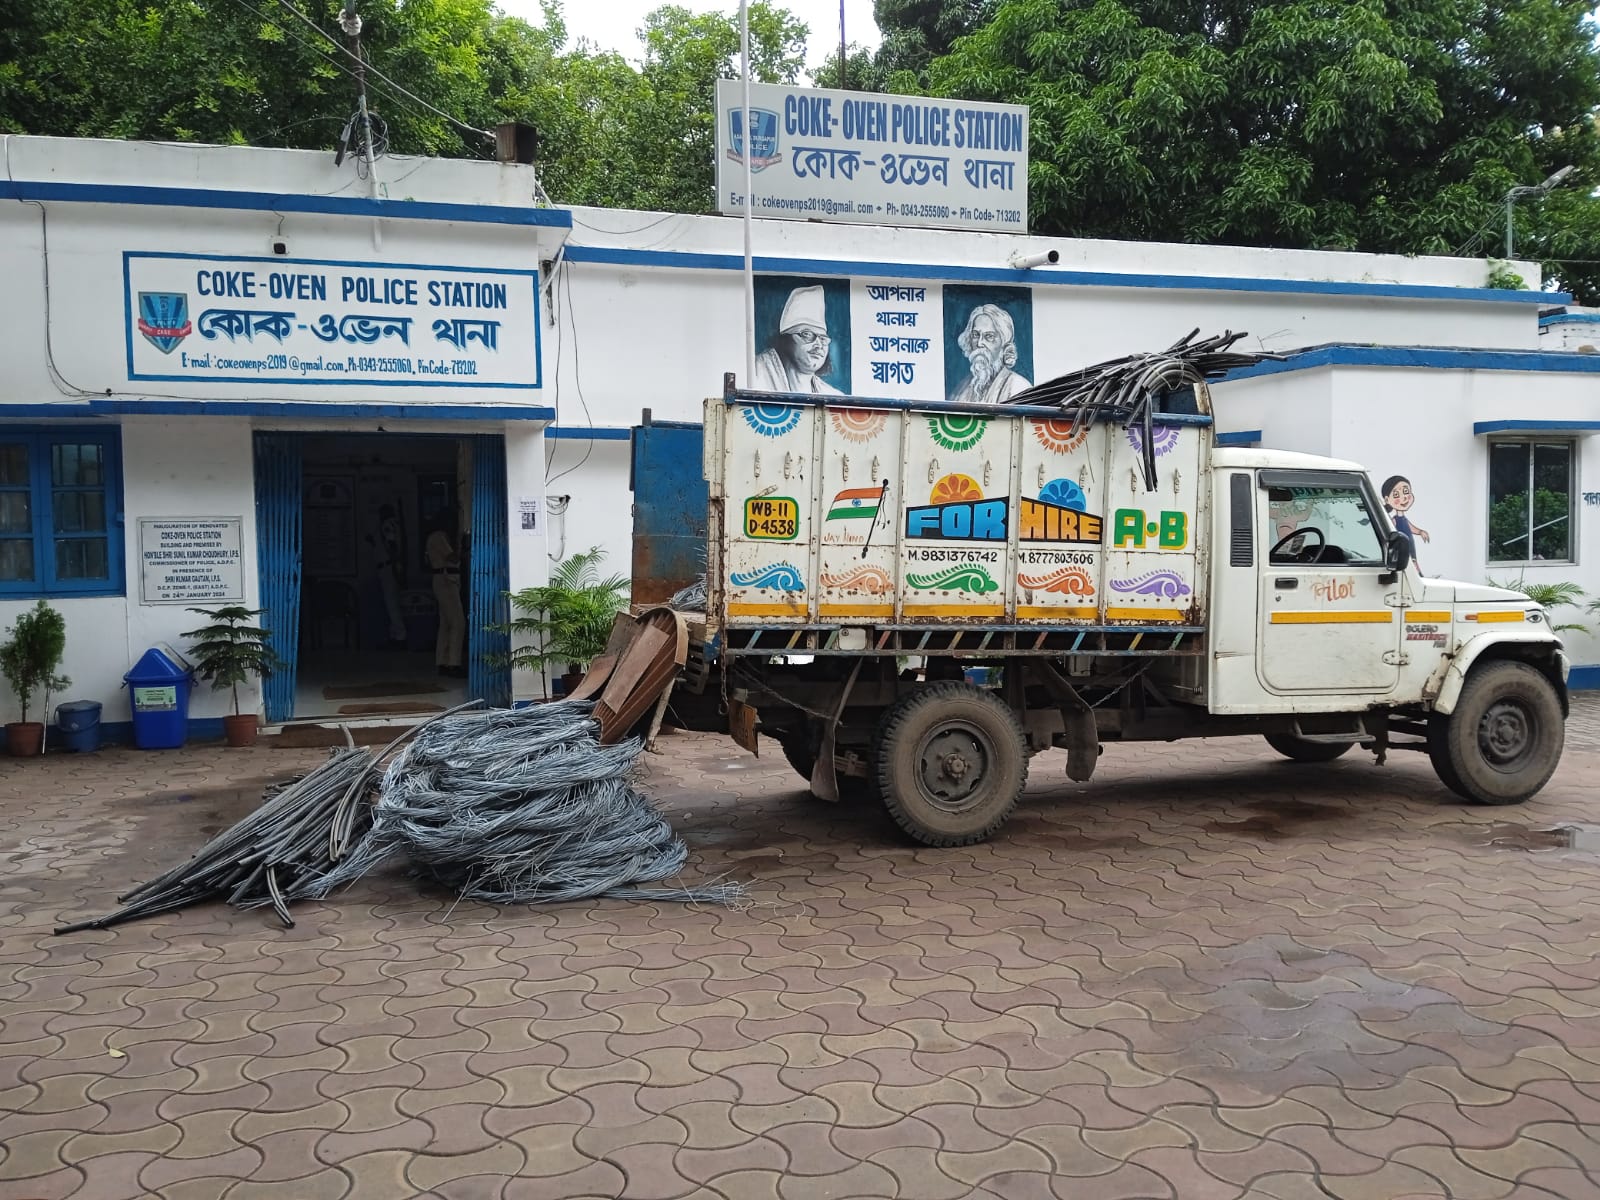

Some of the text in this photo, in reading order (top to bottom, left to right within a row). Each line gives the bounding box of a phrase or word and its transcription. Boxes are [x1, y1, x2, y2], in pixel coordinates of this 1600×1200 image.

[842, 99, 887, 142] OVEN
[891, 103, 950, 147] POLICE
[954, 108, 1023, 152] STATION
[964, 158, 1015, 191] থানা
[996, 209, 1021, 222] 713202
[341, 276, 418, 306] POLICE
[428, 280, 507, 309] STATION
[866, 285, 926, 302] আপনার
[876, 311, 919, 327] থানায়
[432, 318, 502, 352] থানা
[869, 336, 931, 353] আপনাকে
[871, 361, 915, 385] স্বাগত
[908, 499, 1101, 541] FOR HIRE
[202, 531, 222, 540] STATION
